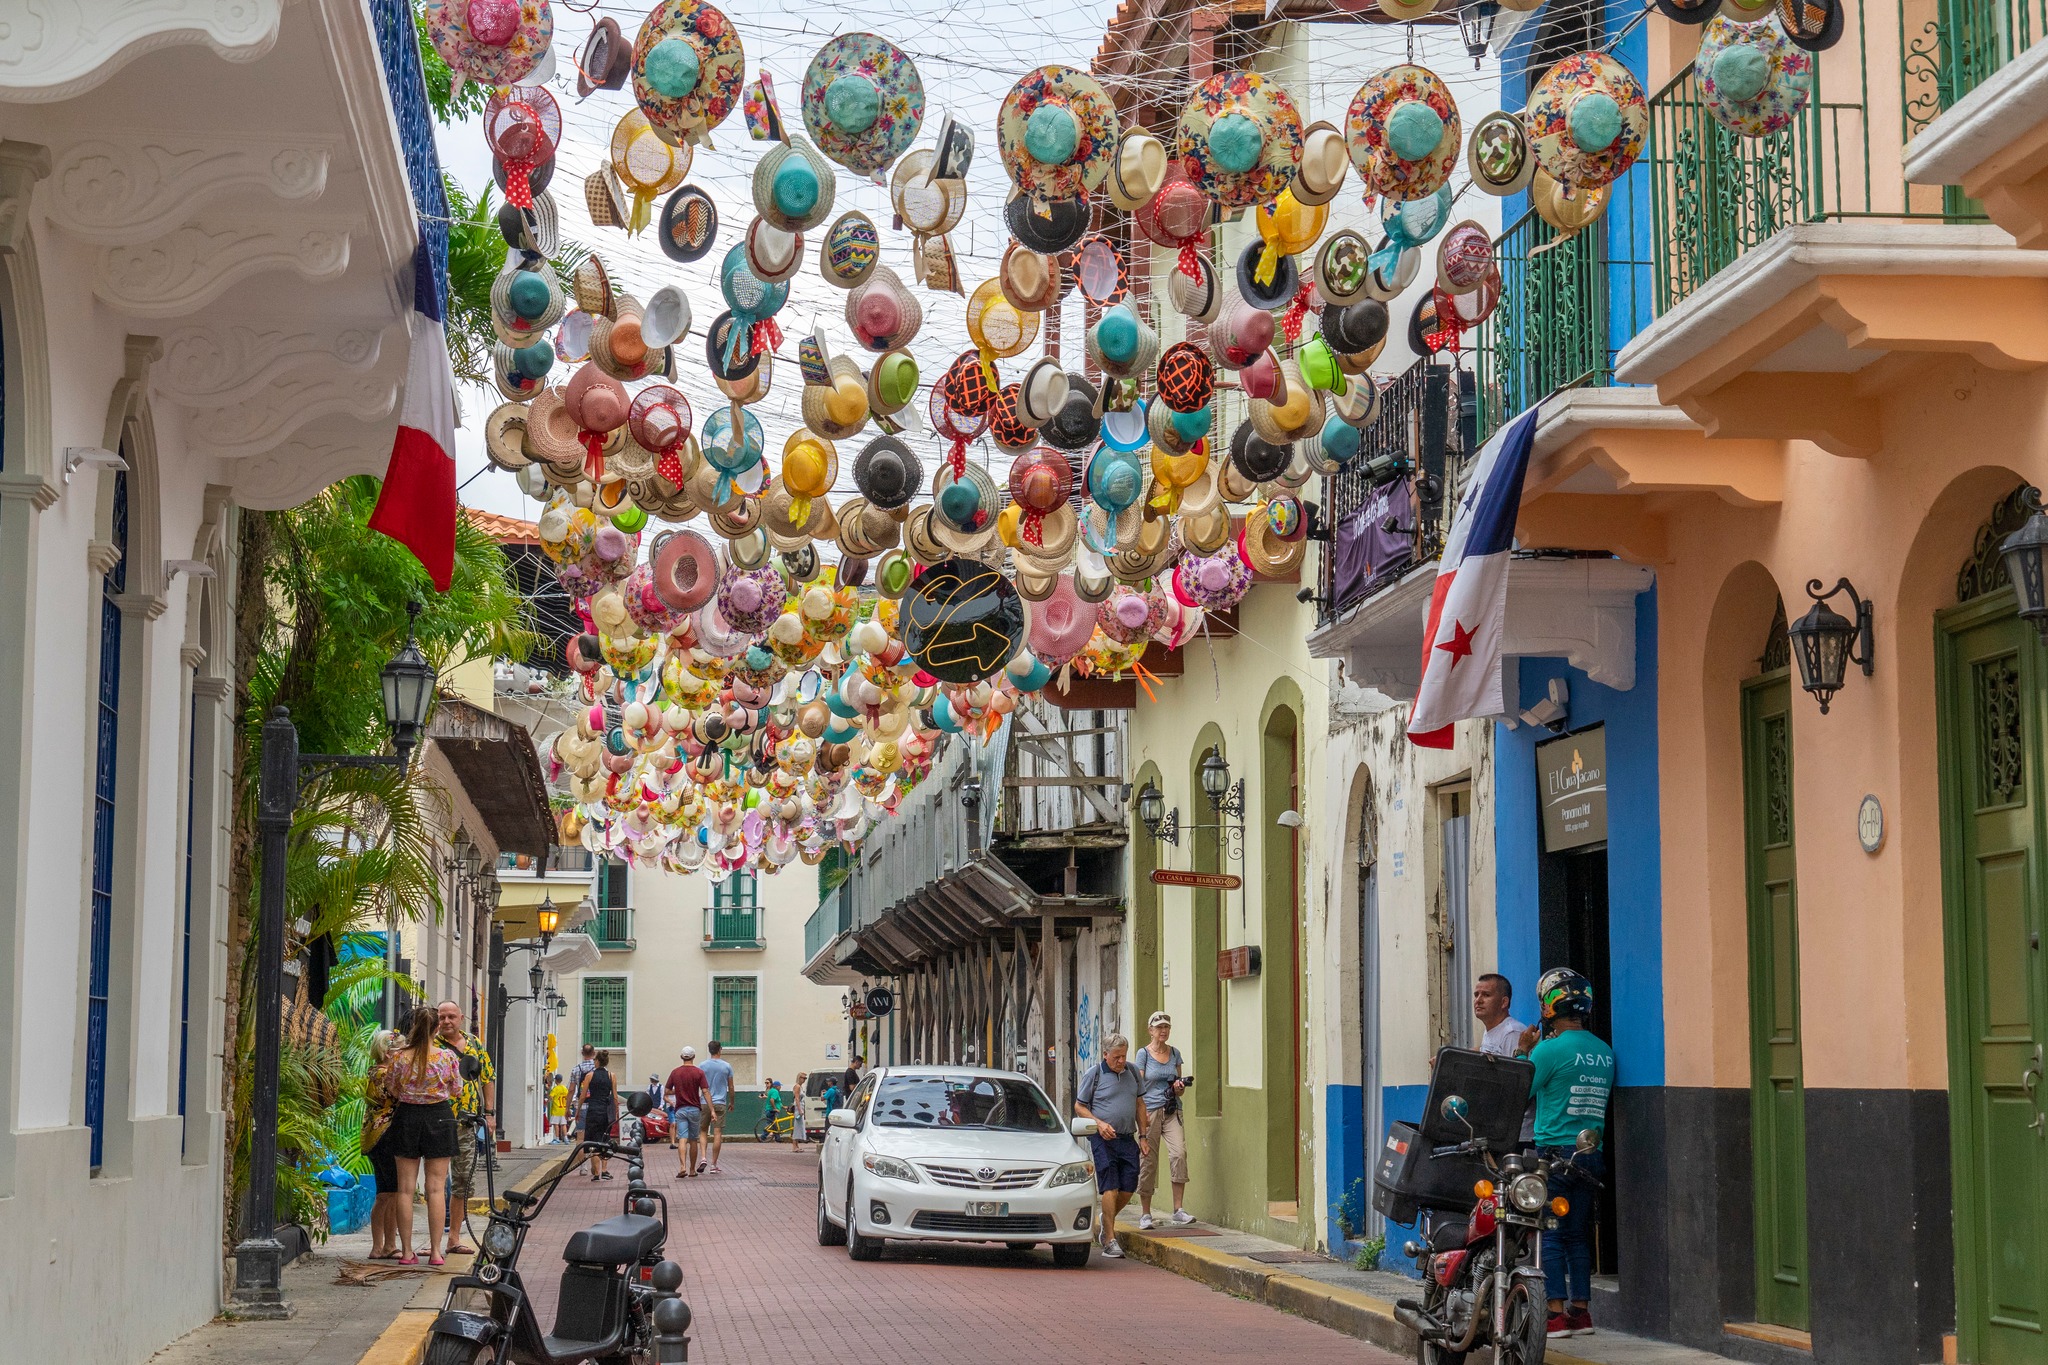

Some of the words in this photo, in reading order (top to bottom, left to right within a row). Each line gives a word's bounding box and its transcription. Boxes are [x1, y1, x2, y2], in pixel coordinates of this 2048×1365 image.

[1861, 808, 1880, 839] 8-69
[1166, 874, 1183, 882] CASA
[1196, 877, 1224, 885] HABANO
[1574, 1053, 1613, 1067] ASAP
